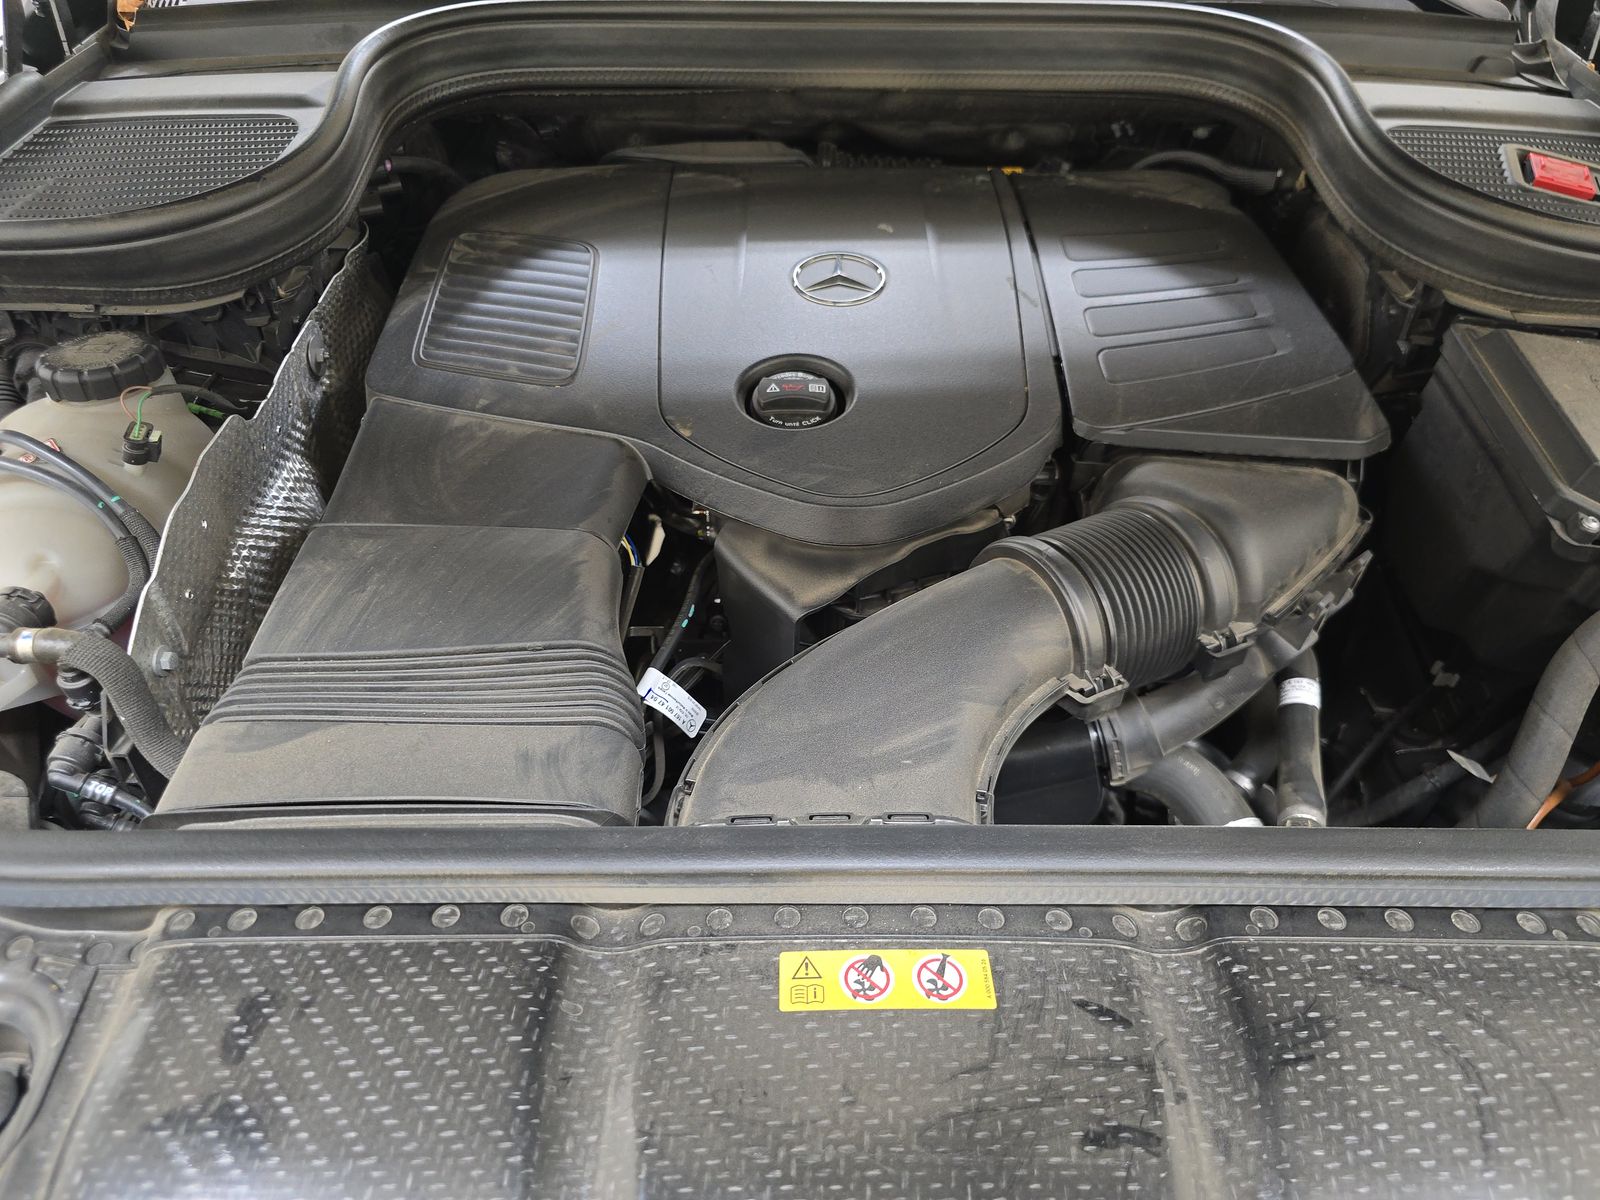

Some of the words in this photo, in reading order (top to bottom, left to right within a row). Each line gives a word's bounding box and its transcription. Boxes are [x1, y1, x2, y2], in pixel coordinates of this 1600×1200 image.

[769, 415, 783, 425] Turn
[801, 415, 822, 426] CLICK
[88, 780, 116, 798] TOP
